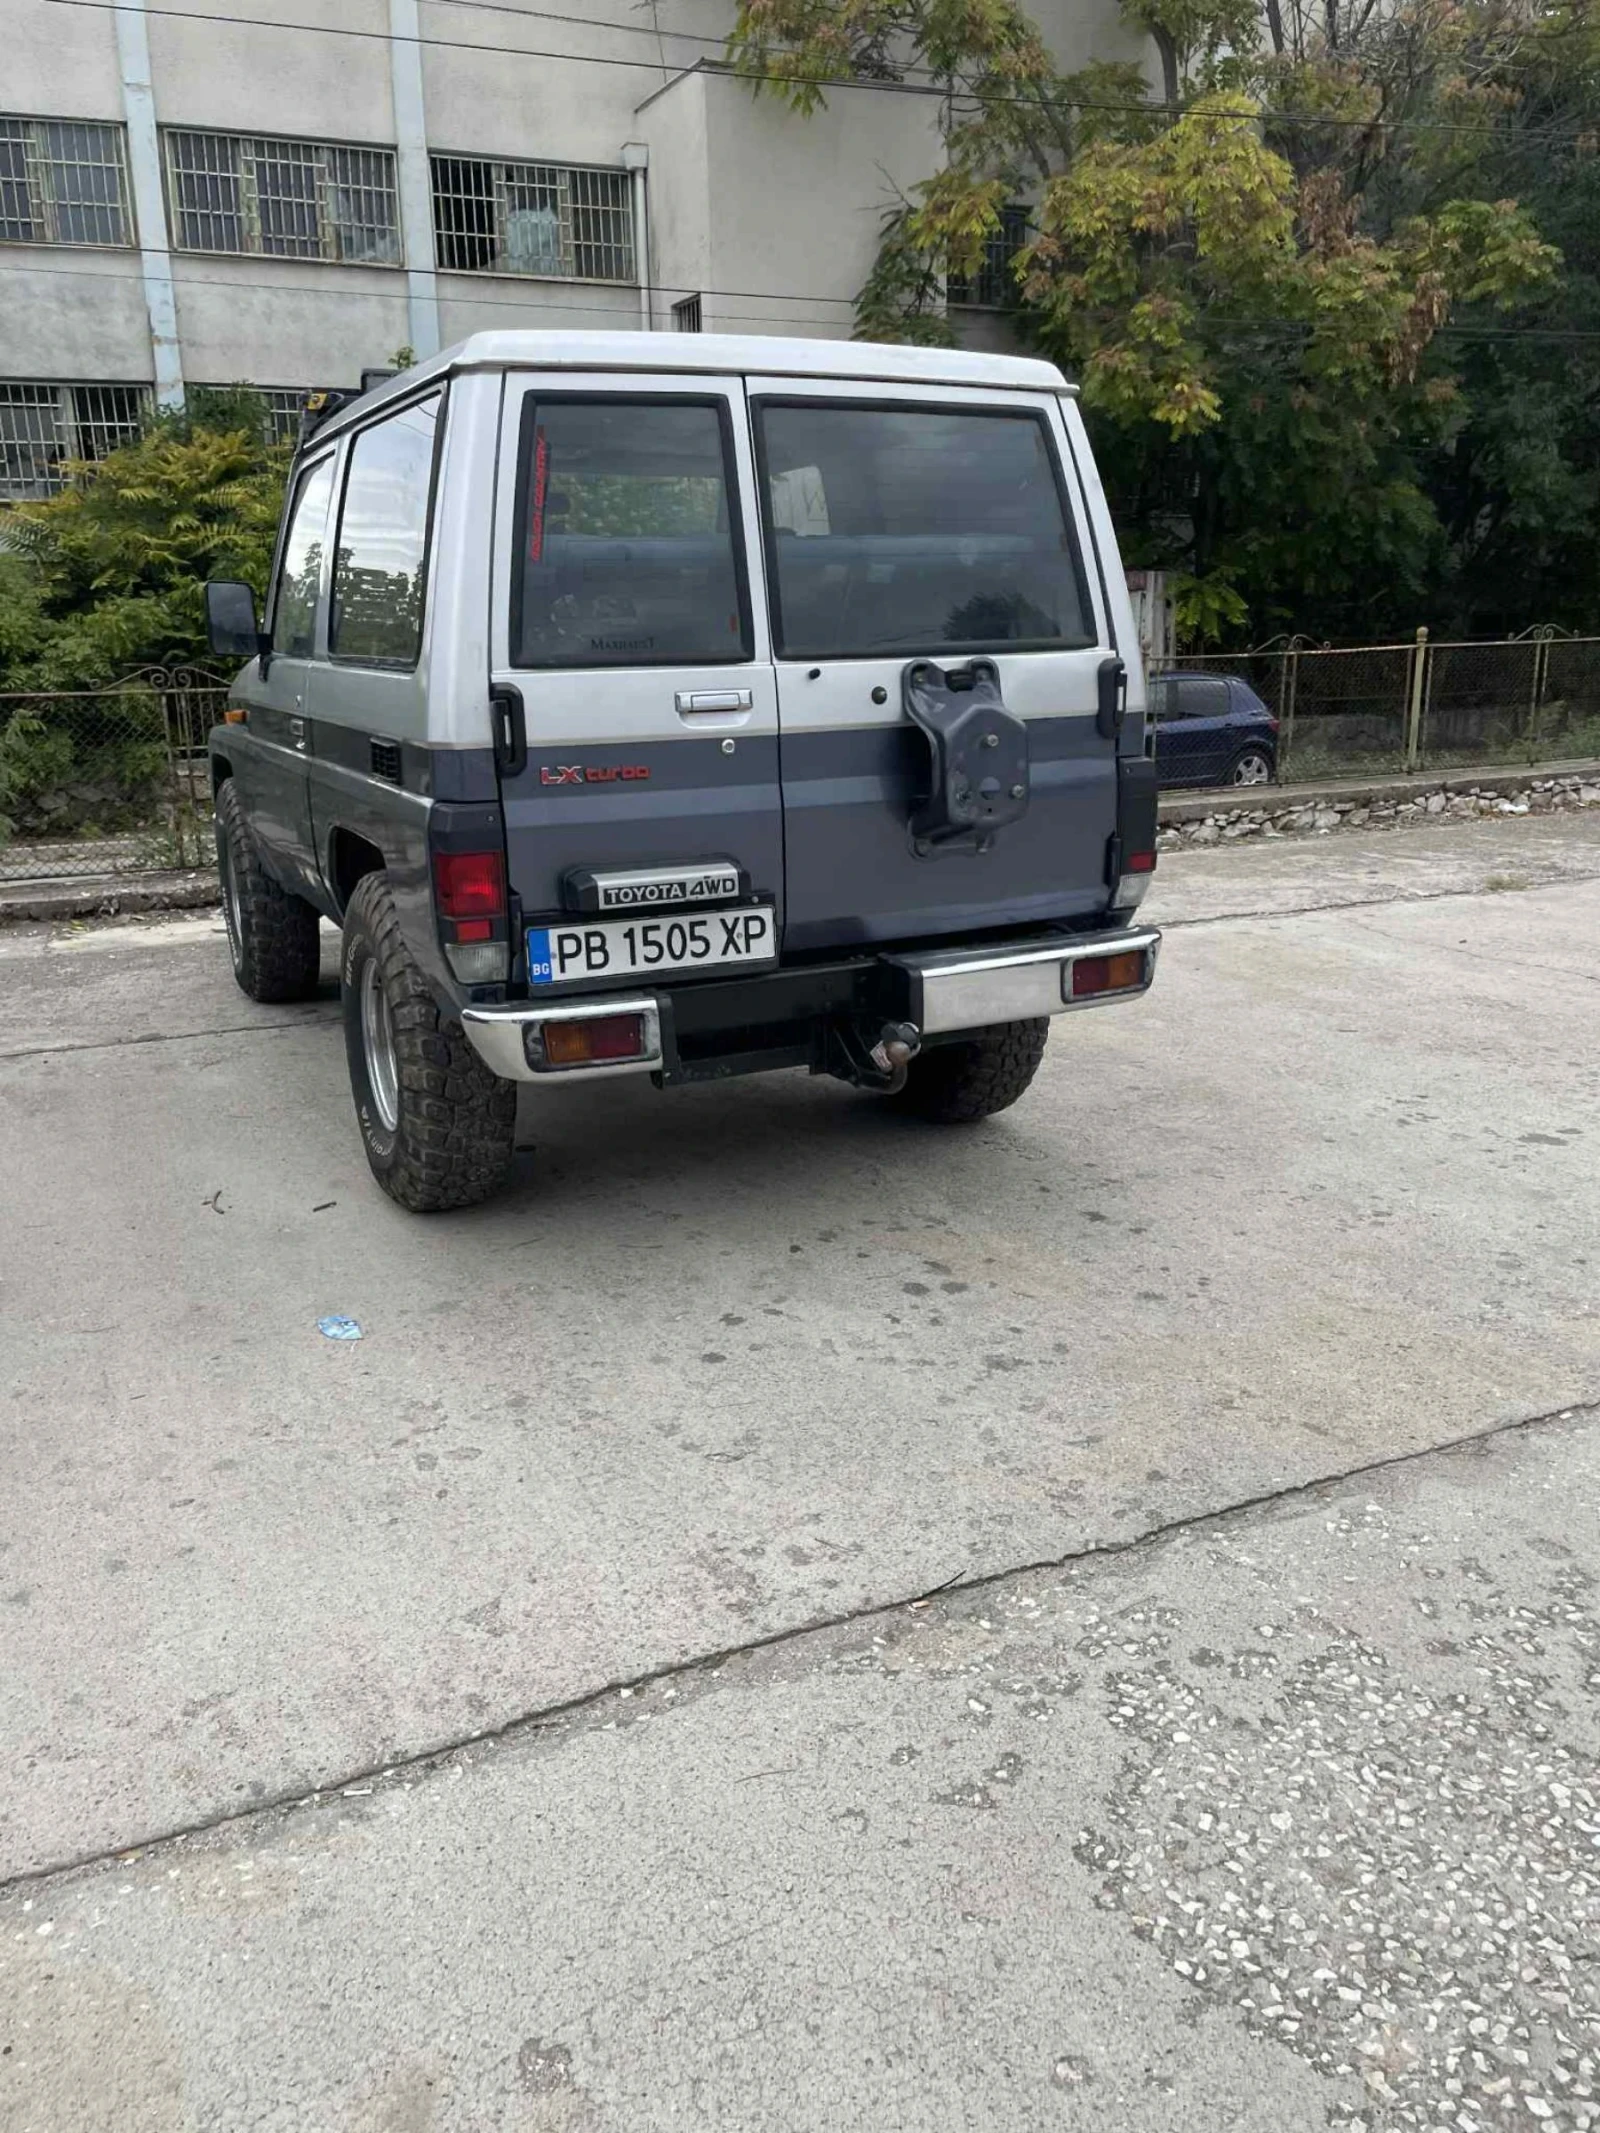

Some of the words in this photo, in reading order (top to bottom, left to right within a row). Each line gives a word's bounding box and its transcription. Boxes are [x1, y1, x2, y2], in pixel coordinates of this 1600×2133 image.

[541, 766, 582, 785] LX
[585, 766, 651, 782] turbo
[607, 883, 683, 903] TOYOTA
[690, 876, 736, 897] 4WD
[557, 930, 610, 974] PB
[623, 920, 710, 966] 1505
[720, 914, 767, 957] XP
[532, 963, 550, 976] BG
